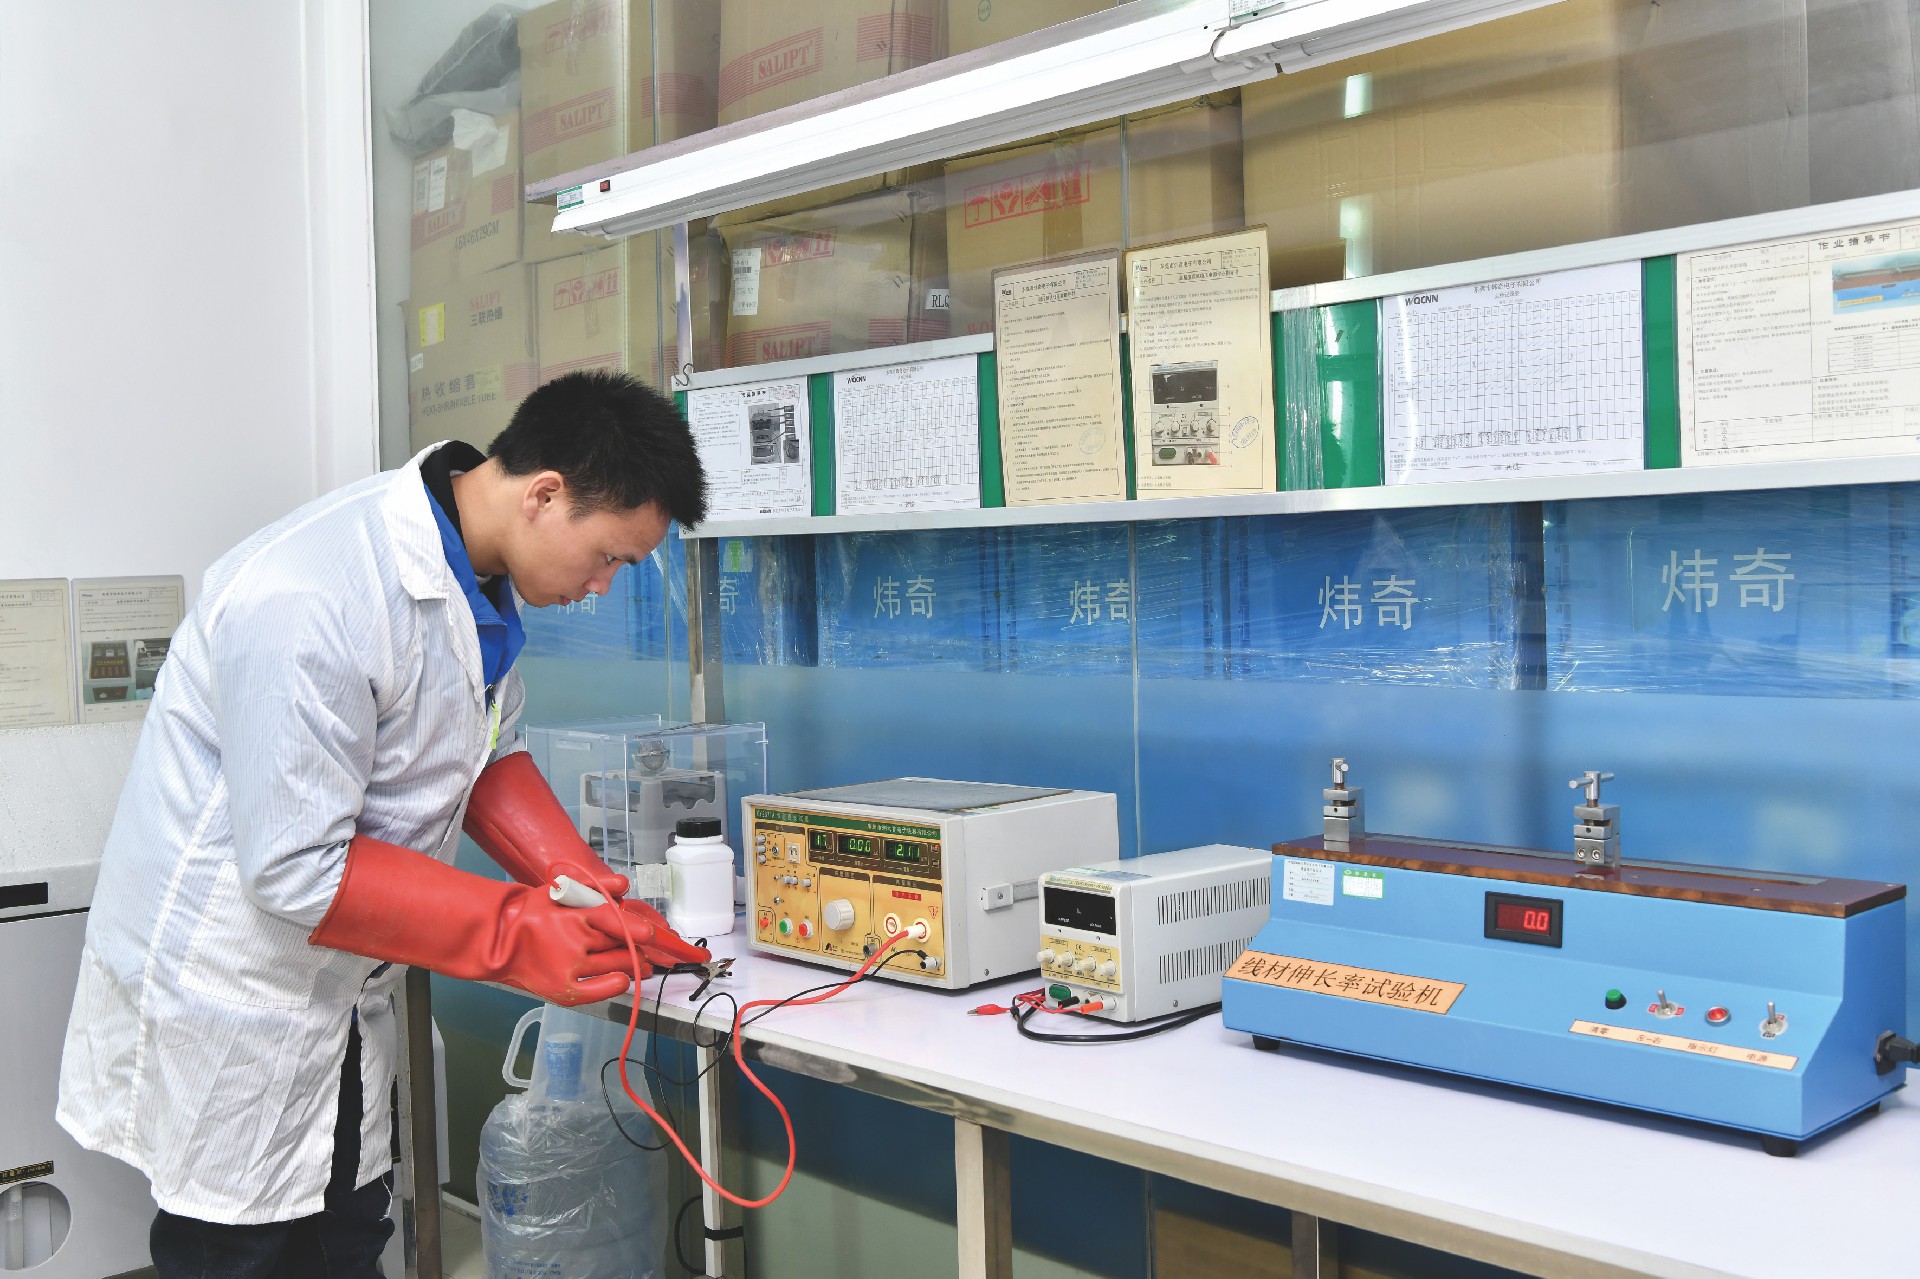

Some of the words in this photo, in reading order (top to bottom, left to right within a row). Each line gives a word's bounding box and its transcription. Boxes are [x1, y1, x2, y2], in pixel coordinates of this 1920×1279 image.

[758, 46, 811, 79] SALIPT
[560, 101, 606, 131] SALIPT
[1818, 233, 1891, 250] 作业指导书
[762, 336, 815, 361] SALIPT
[873, 575, 937, 620] 炜奇
[1661, 547, 1795, 613] 炜奇
[1069, 578, 1139, 627] 炜奇
[1318, 575, 1420, 630] 炜奇
[1523, 910, 1549, 931] 0.0
[1237, 956, 1444, 1007] 线材伸长率试验机
